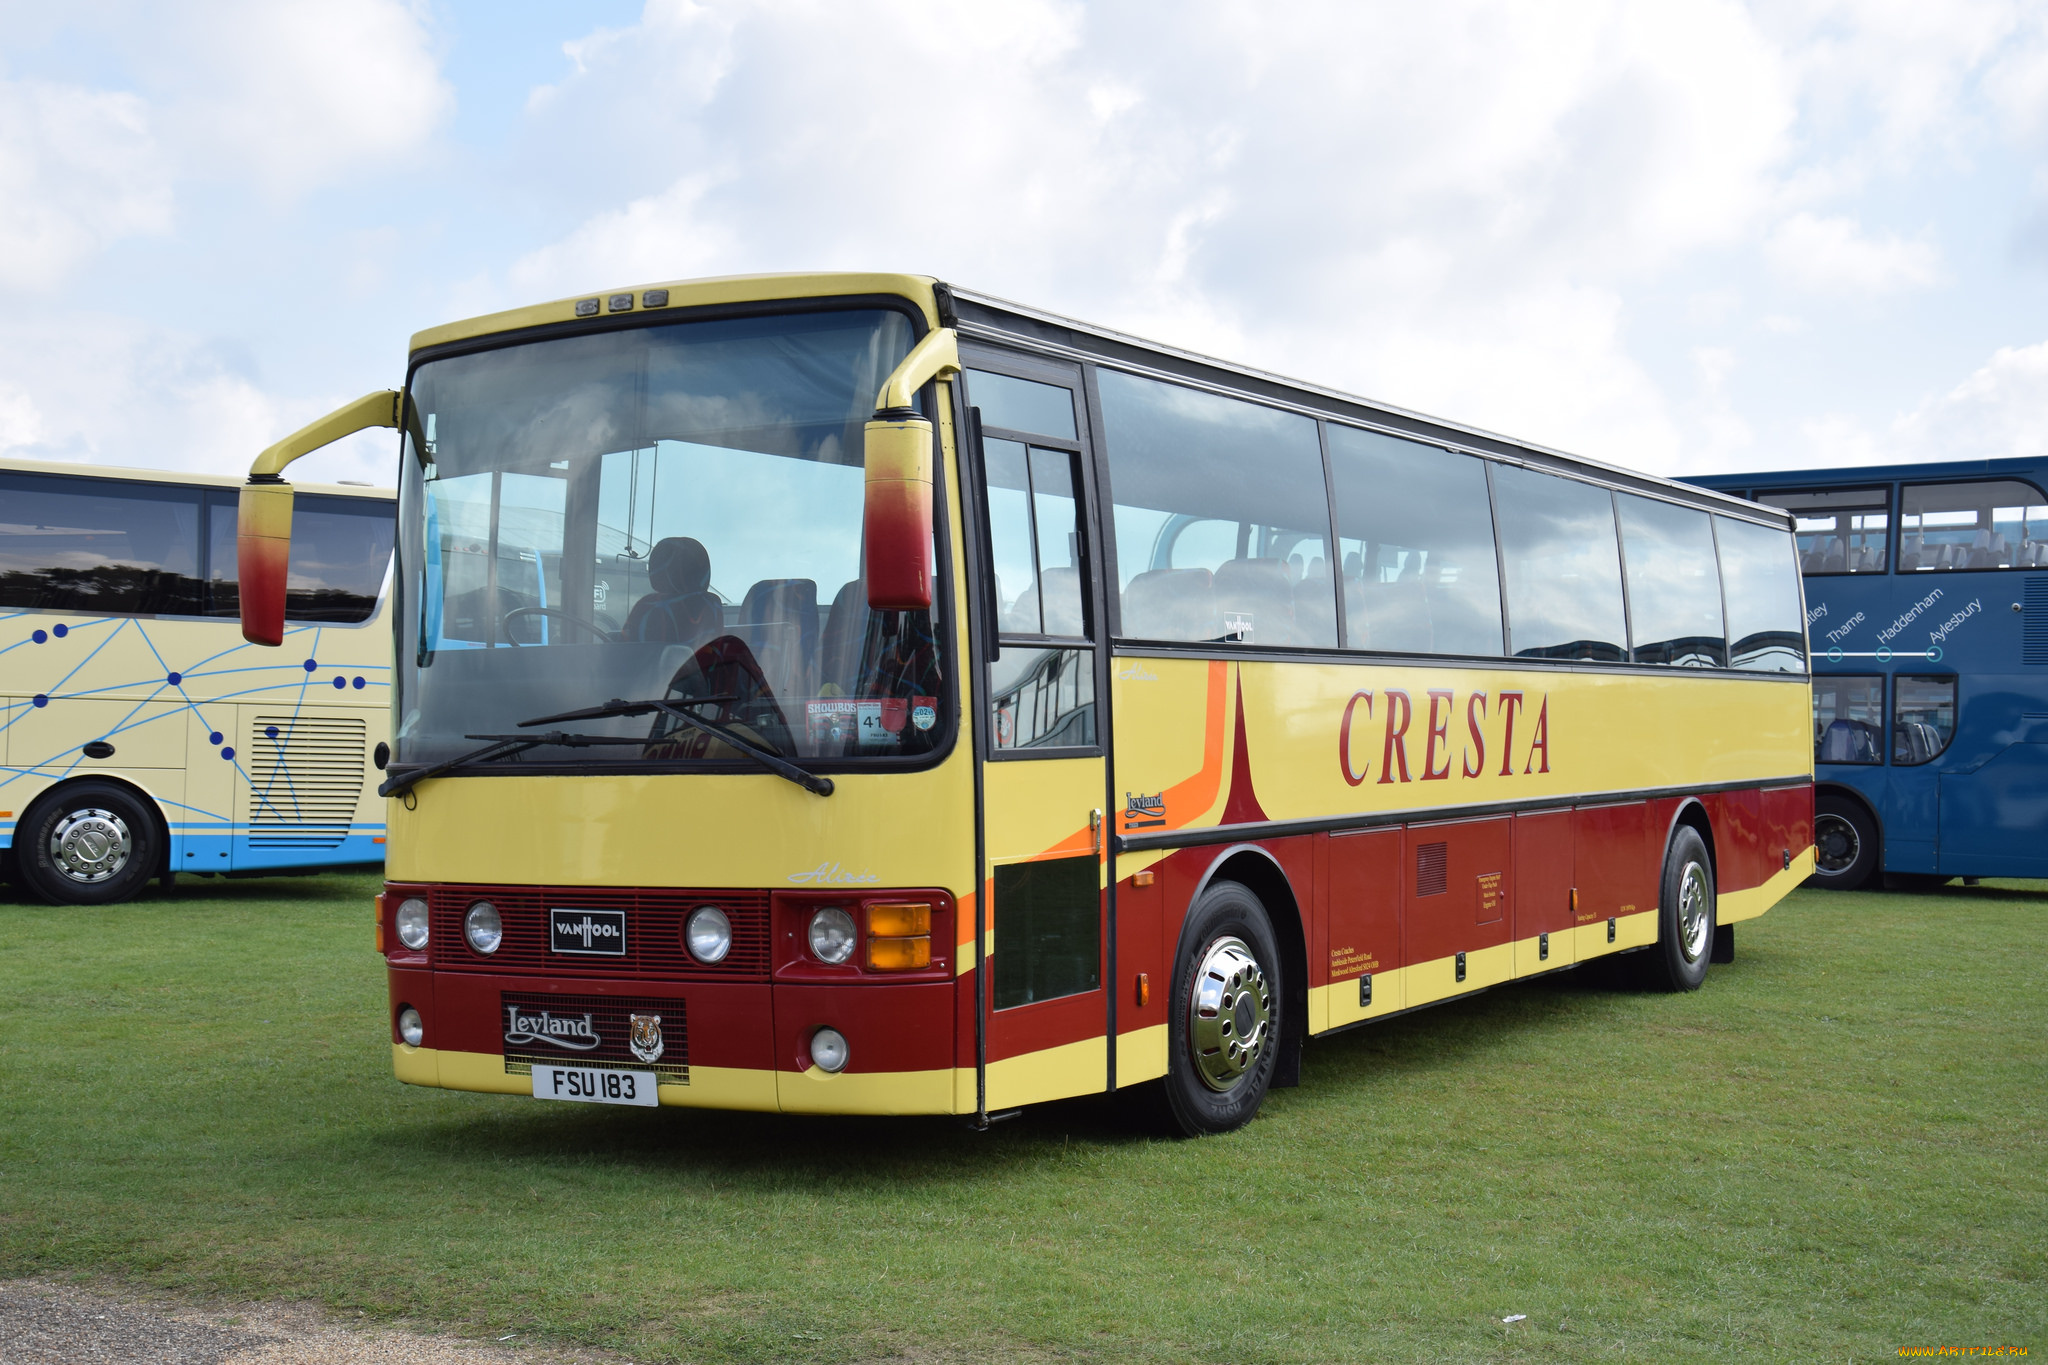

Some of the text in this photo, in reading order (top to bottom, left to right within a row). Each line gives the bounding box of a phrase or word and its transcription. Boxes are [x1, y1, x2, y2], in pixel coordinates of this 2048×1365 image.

[1826, 610, 1866, 644] Thame
[1876, 587, 1944, 645] Haddenham
[1929, 598, 1982, 645] Aylesbury
[808, 702, 857, 713] SHOWBUS
[1339, 687, 1551, 787] CRESTA
[1125, 792, 1166, 817] Leyland
[505, 1006, 600, 1049] Leyland
[552, 1070, 636, 1099] FSU 183
